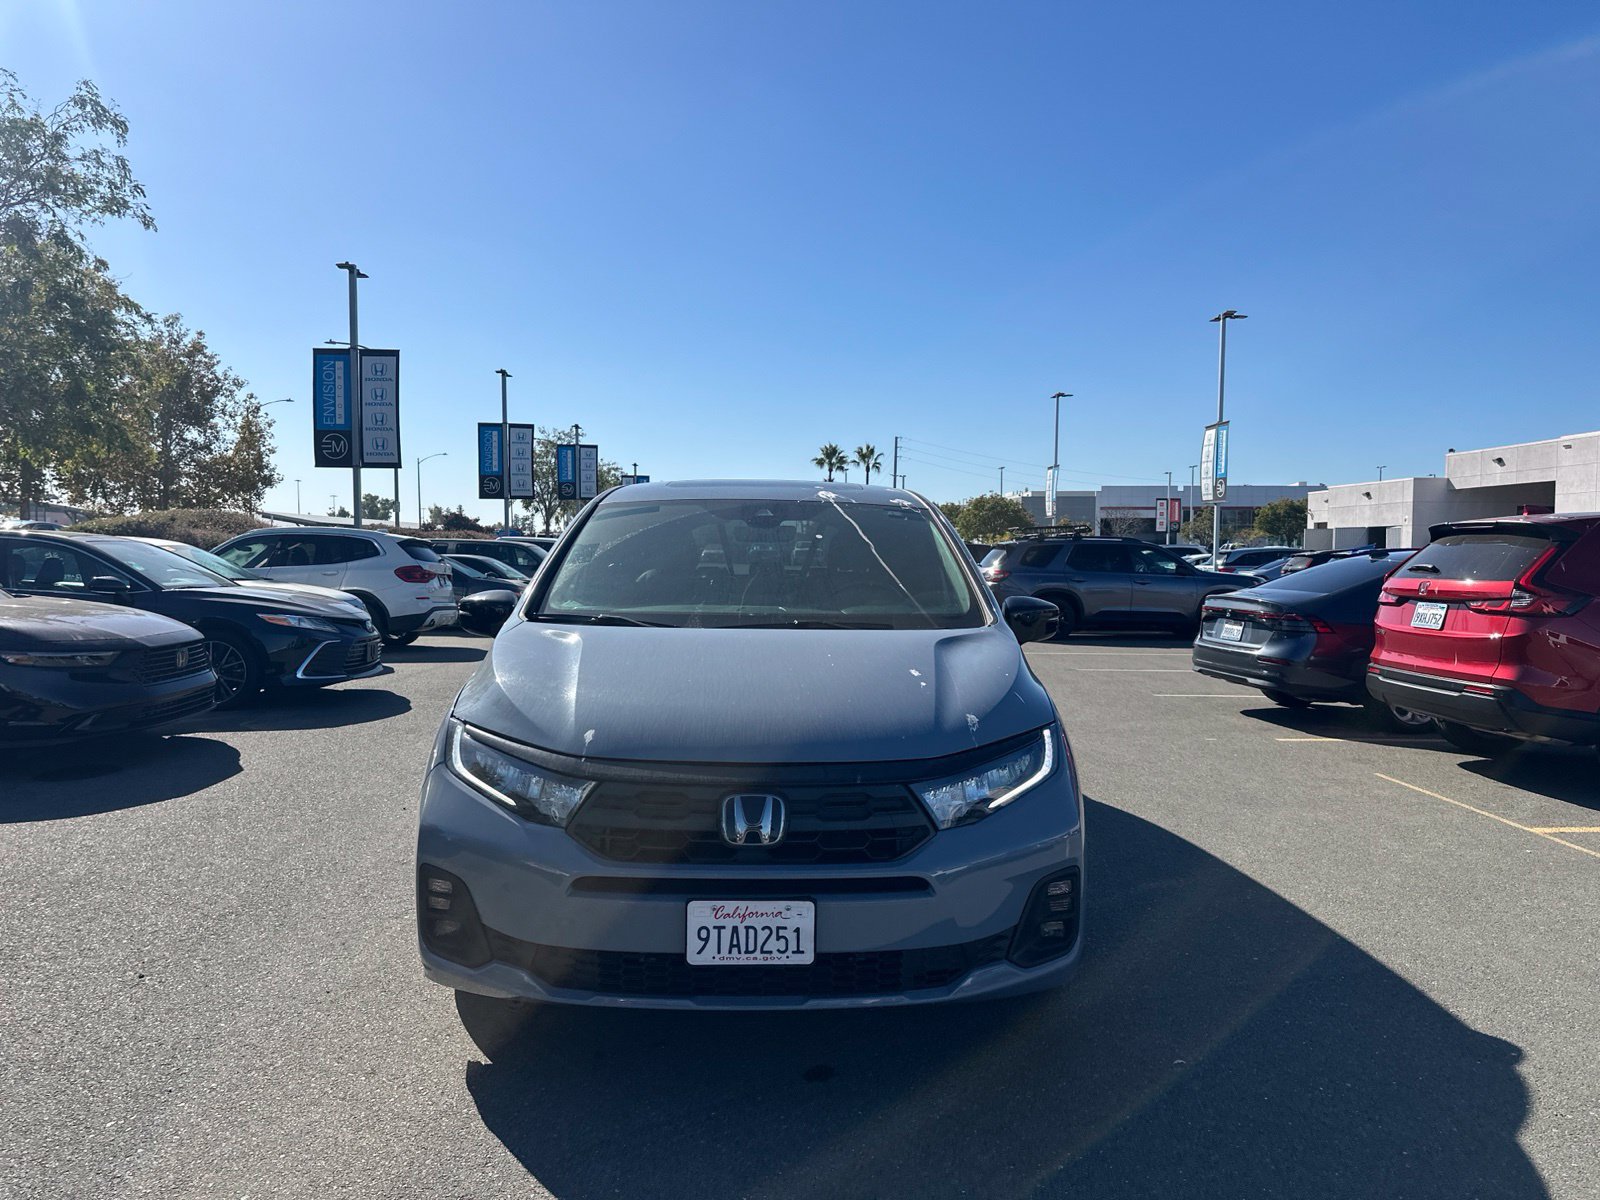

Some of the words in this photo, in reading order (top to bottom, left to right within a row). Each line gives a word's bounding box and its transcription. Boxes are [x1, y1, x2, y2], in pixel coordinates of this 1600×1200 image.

[322, 360, 335, 425] ENVISION
[484, 431, 492, 472] ENVISION
[714, 905, 790, 924] California
[696, 925, 805, 955] 9TAD251
